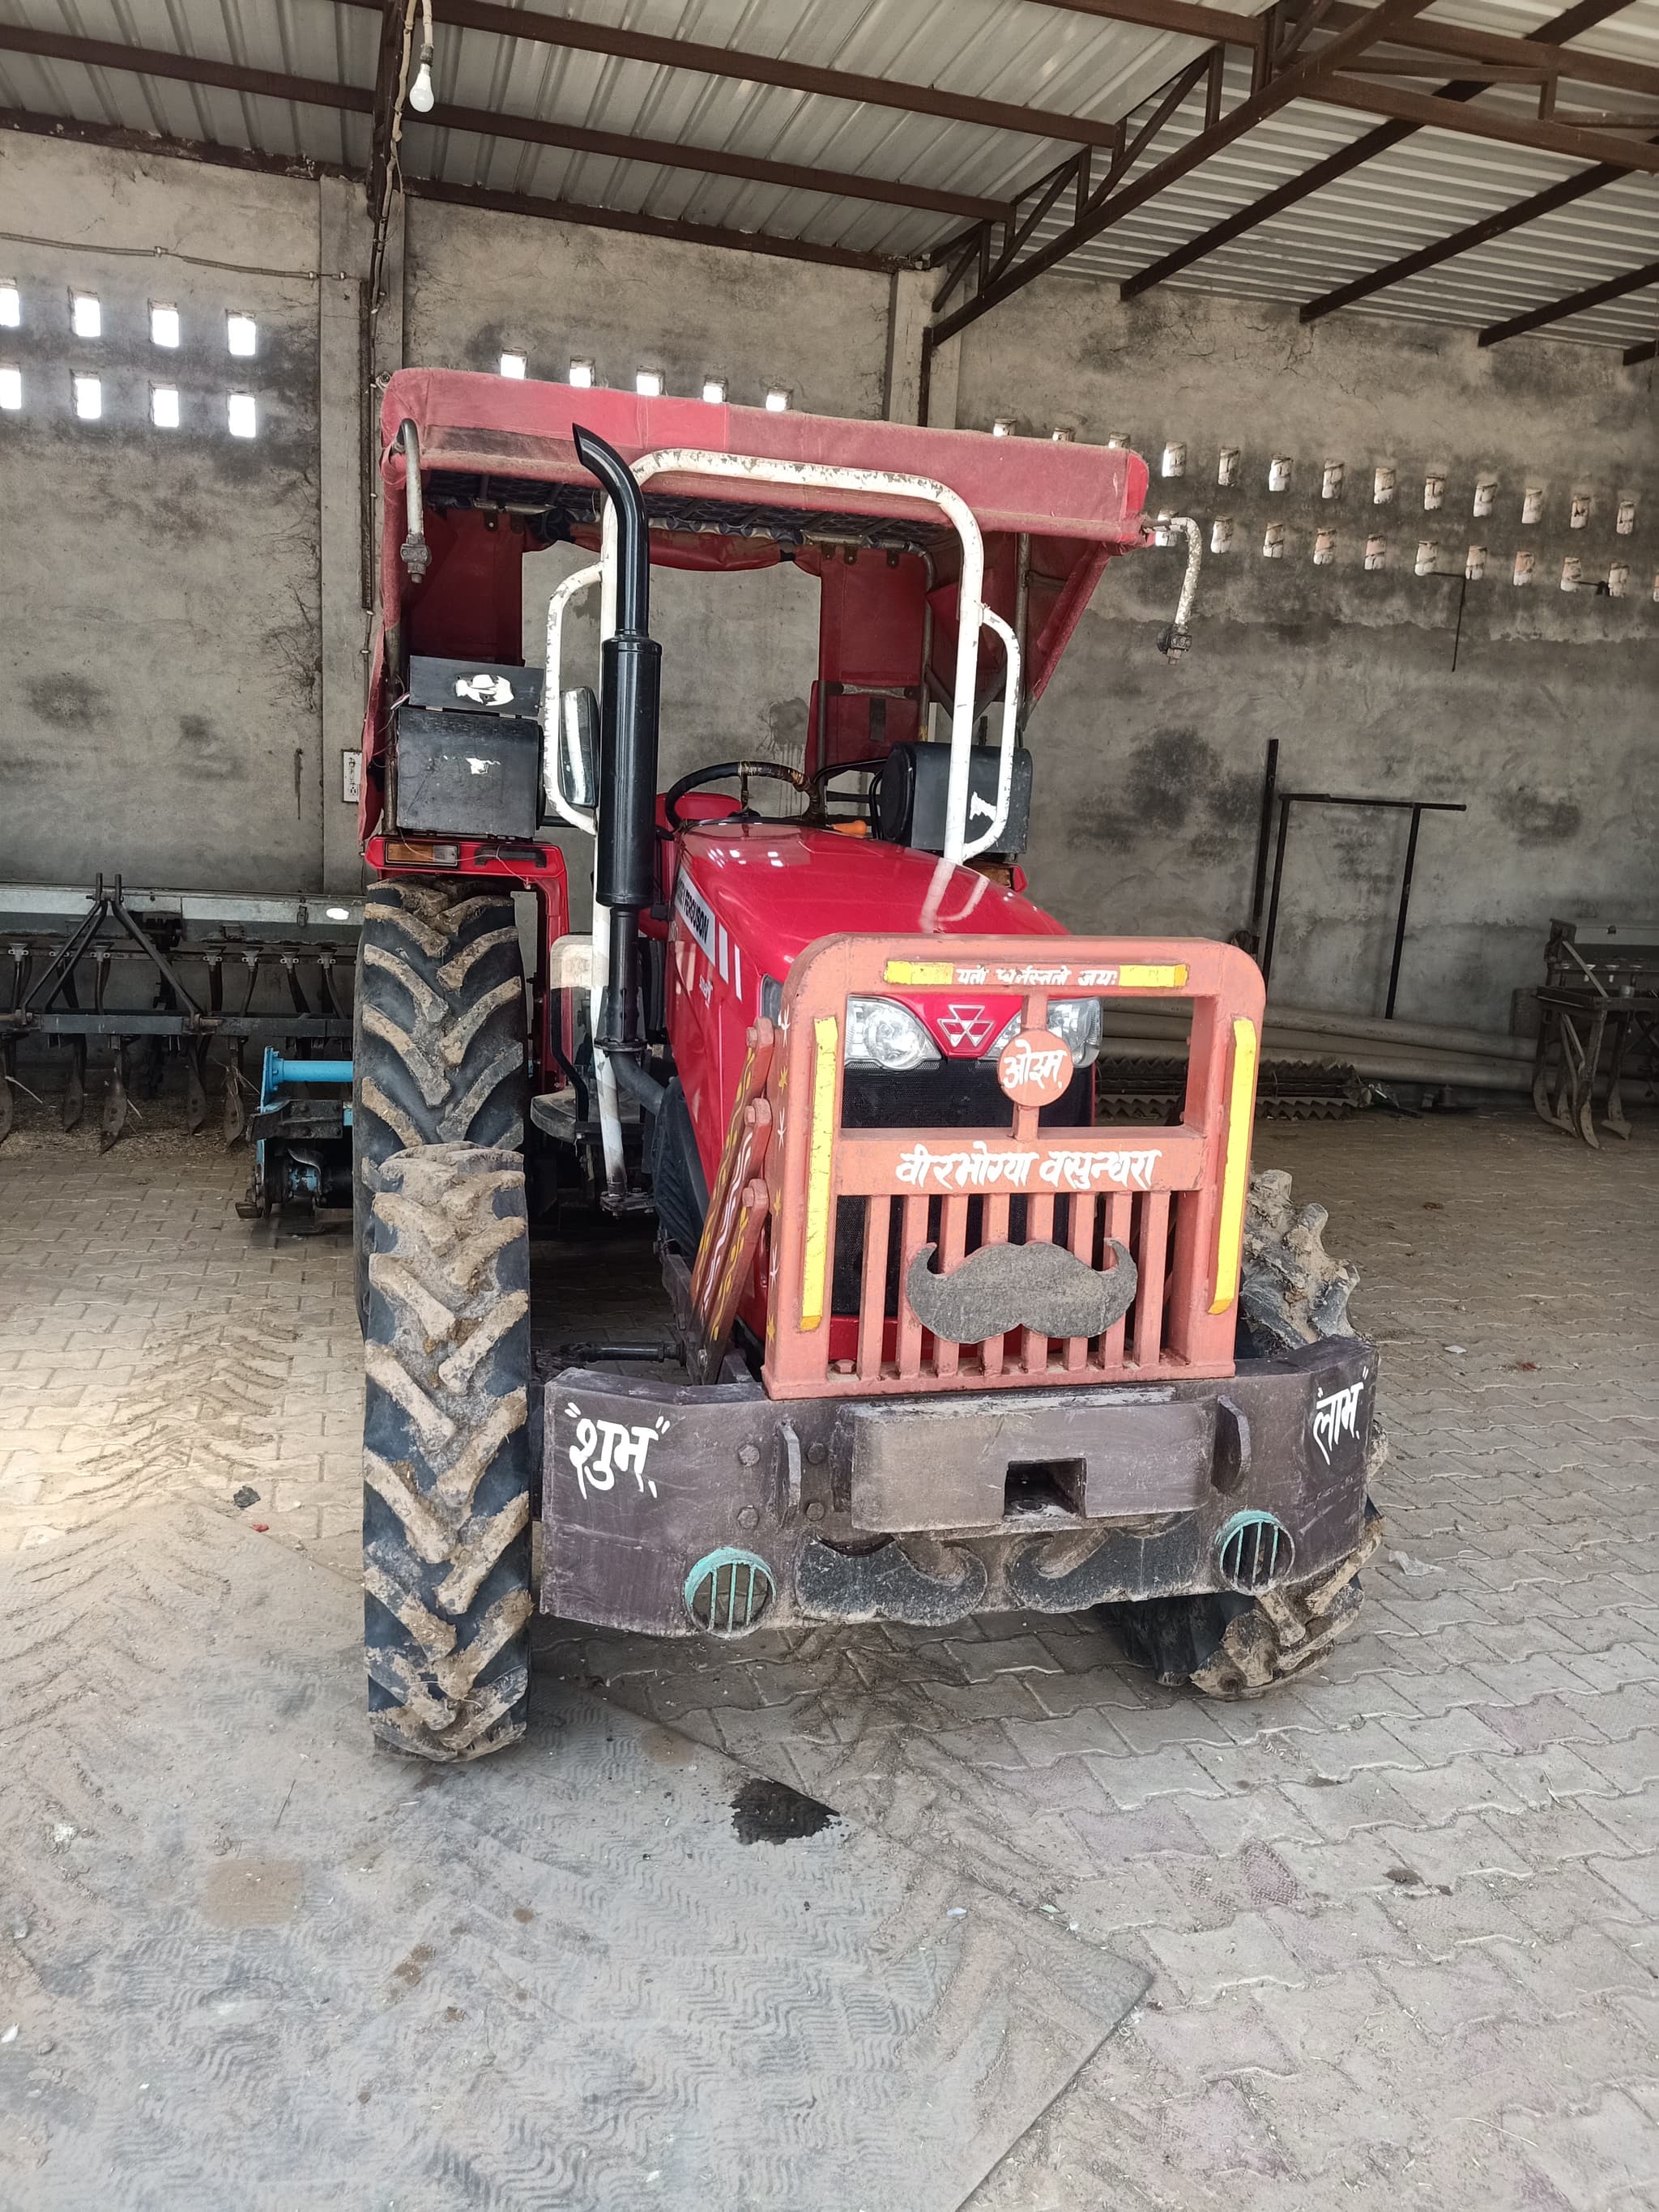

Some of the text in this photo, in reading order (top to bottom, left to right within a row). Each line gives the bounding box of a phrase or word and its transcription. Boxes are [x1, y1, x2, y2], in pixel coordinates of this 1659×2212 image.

[684, 889, 710, 944] FERGUSON
[1077, 970, 1118, 986] जयः
[895, 1140, 1162, 1190] वीरभोग्या वसुन्धरा
